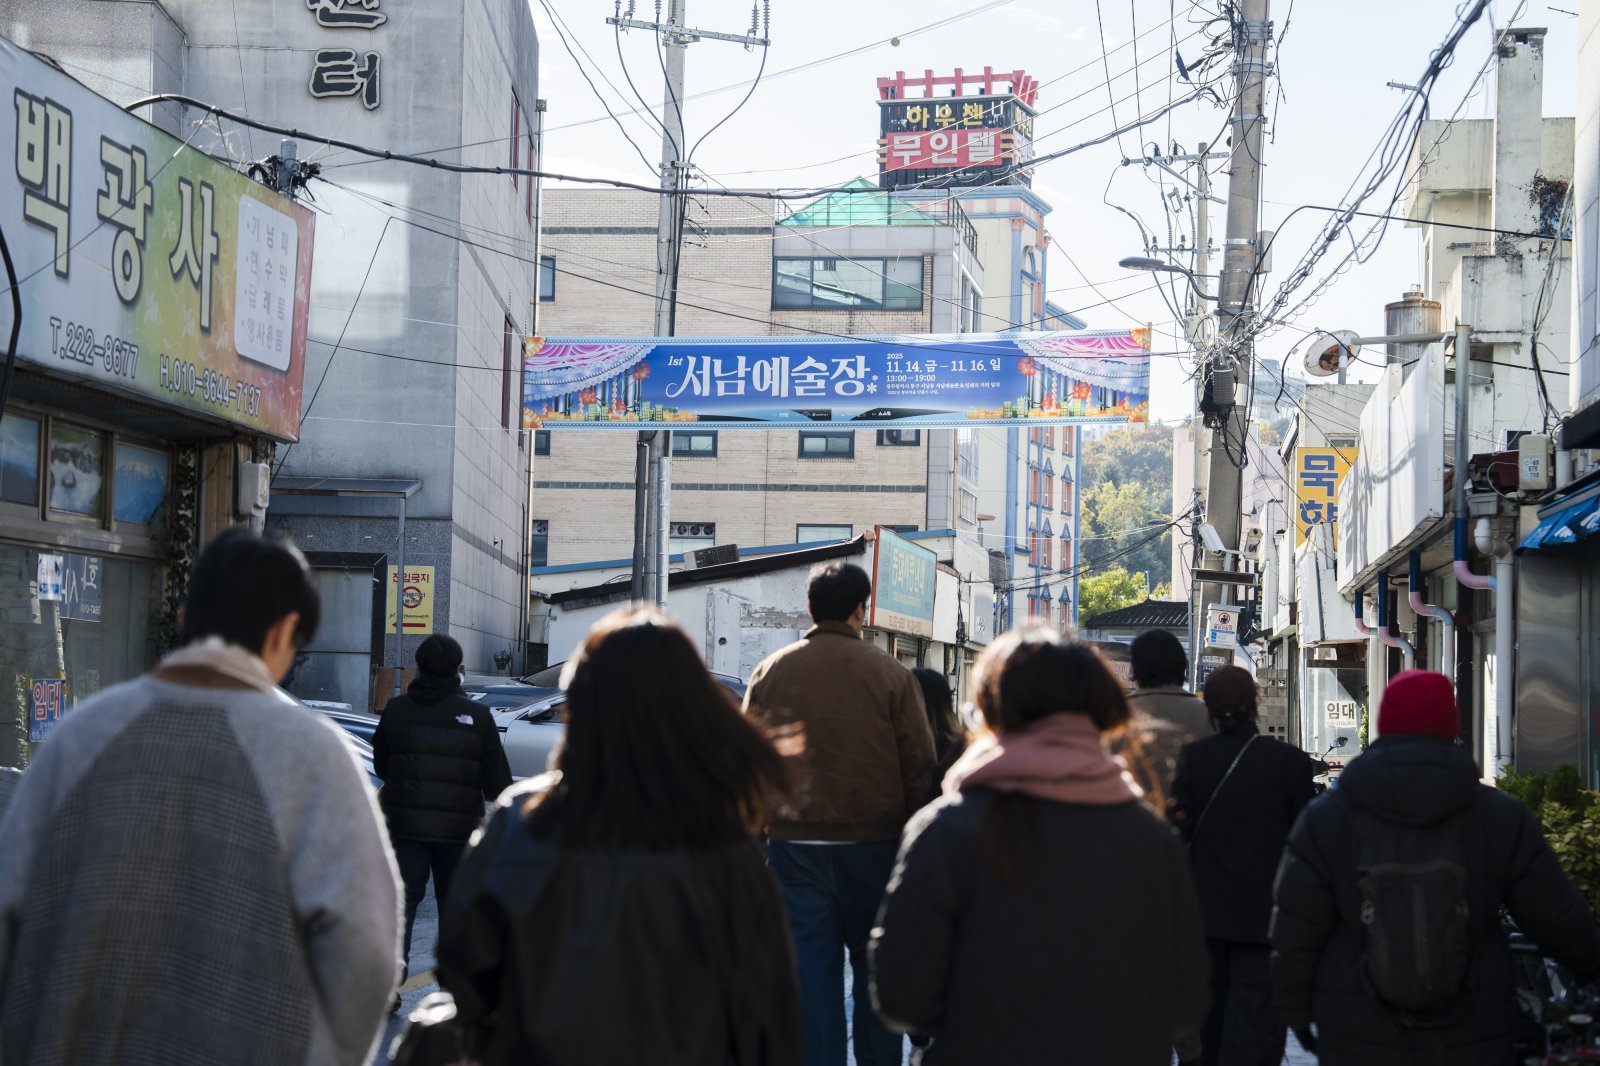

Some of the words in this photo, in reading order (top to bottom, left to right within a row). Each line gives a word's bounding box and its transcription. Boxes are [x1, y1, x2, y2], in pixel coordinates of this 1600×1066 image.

[907, 103, 984, 128] 하우젠
[892, 131, 995, 166] 무인텔
[14, 86, 219, 334] 백광사
[49, 316, 139, 379] T.222-8677
[667, 355, 684, 367] 1st
[886, 360, 903, 373] 11.
[905, 360, 923, 373] 14.
[925, 360, 938, 373] 금
[951, 360, 968, 372] 11.
[970, 360, 987, 372] 16.
[990, 358, 1001, 371] 일
[159, 353, 262, 417] H.010-3644-7137
[665, 354, 871, 398] 서남예술장
[33, 681, 61, 720] 임대
[1327, 702, 1355, 720] 임대
